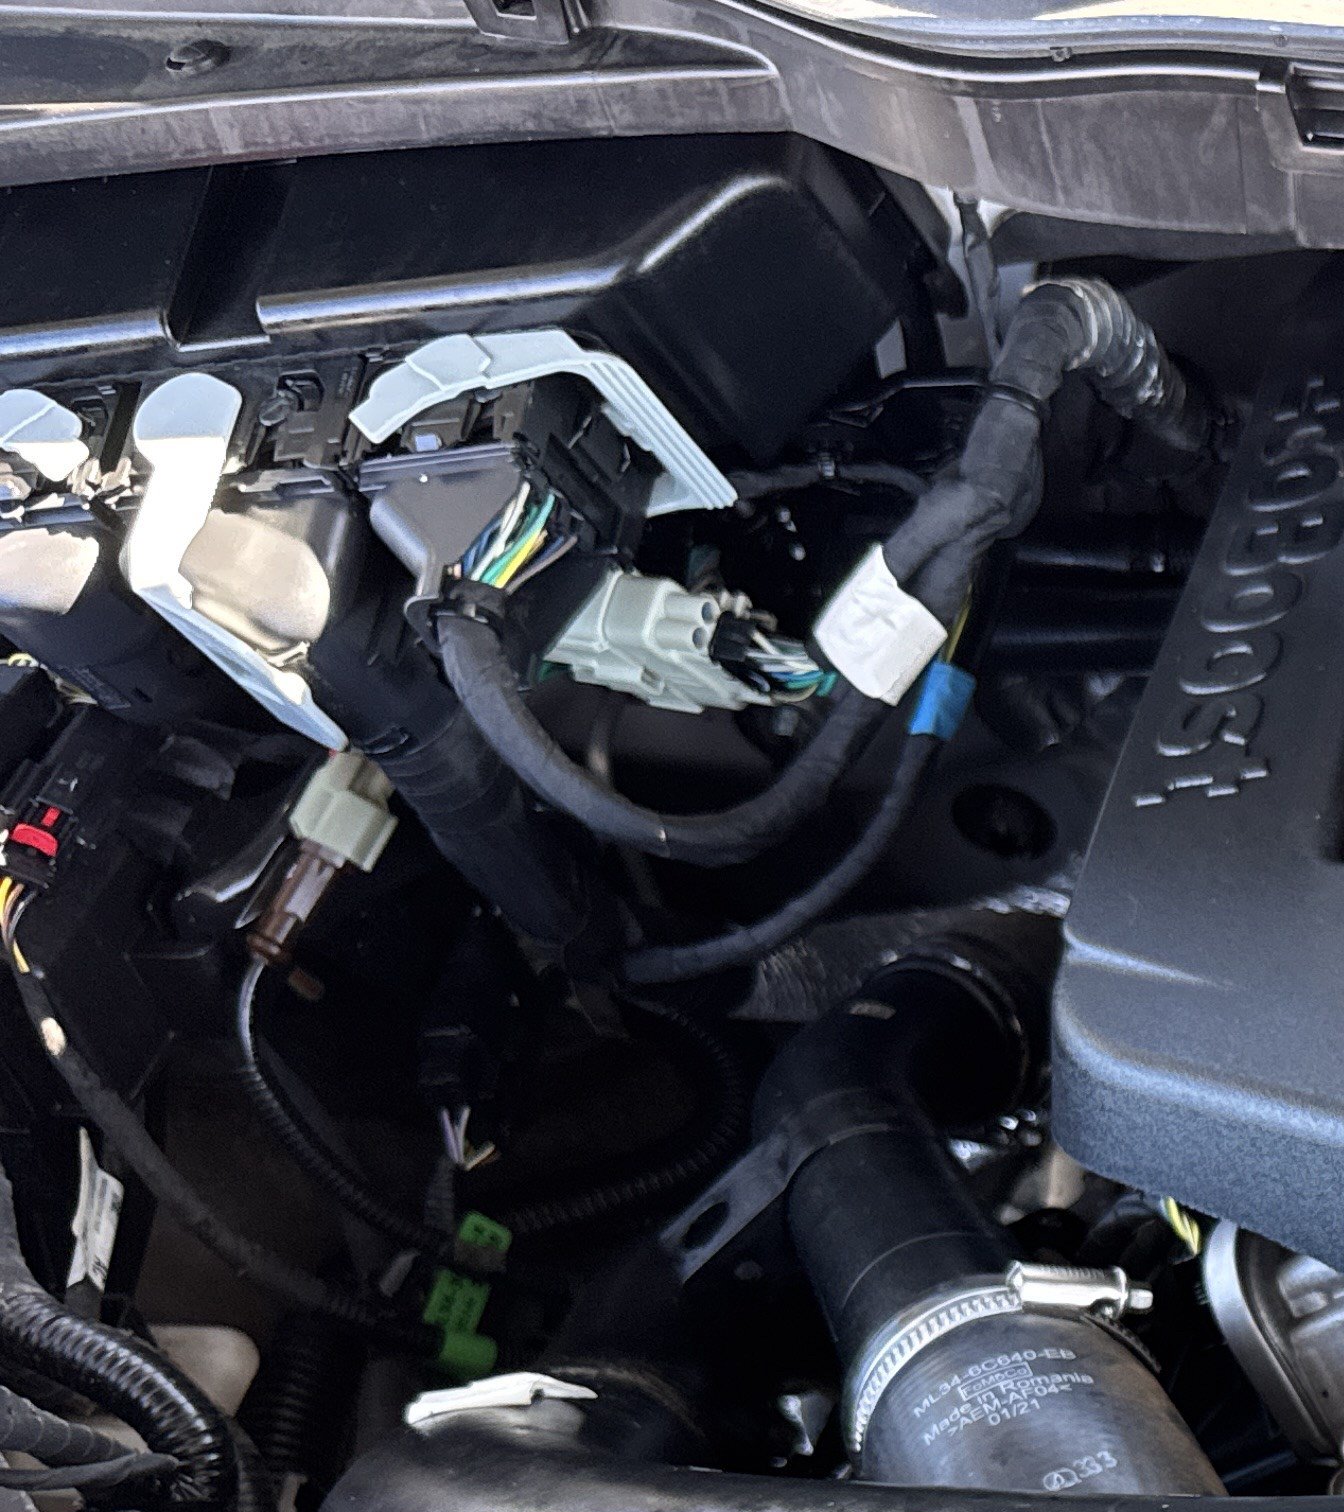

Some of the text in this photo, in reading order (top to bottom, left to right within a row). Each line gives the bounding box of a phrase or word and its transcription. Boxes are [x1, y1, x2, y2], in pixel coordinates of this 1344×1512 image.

[923, 1372, 1094, 1446] Made in Romania
[988, 1398, 1041, 1427] 01/21
